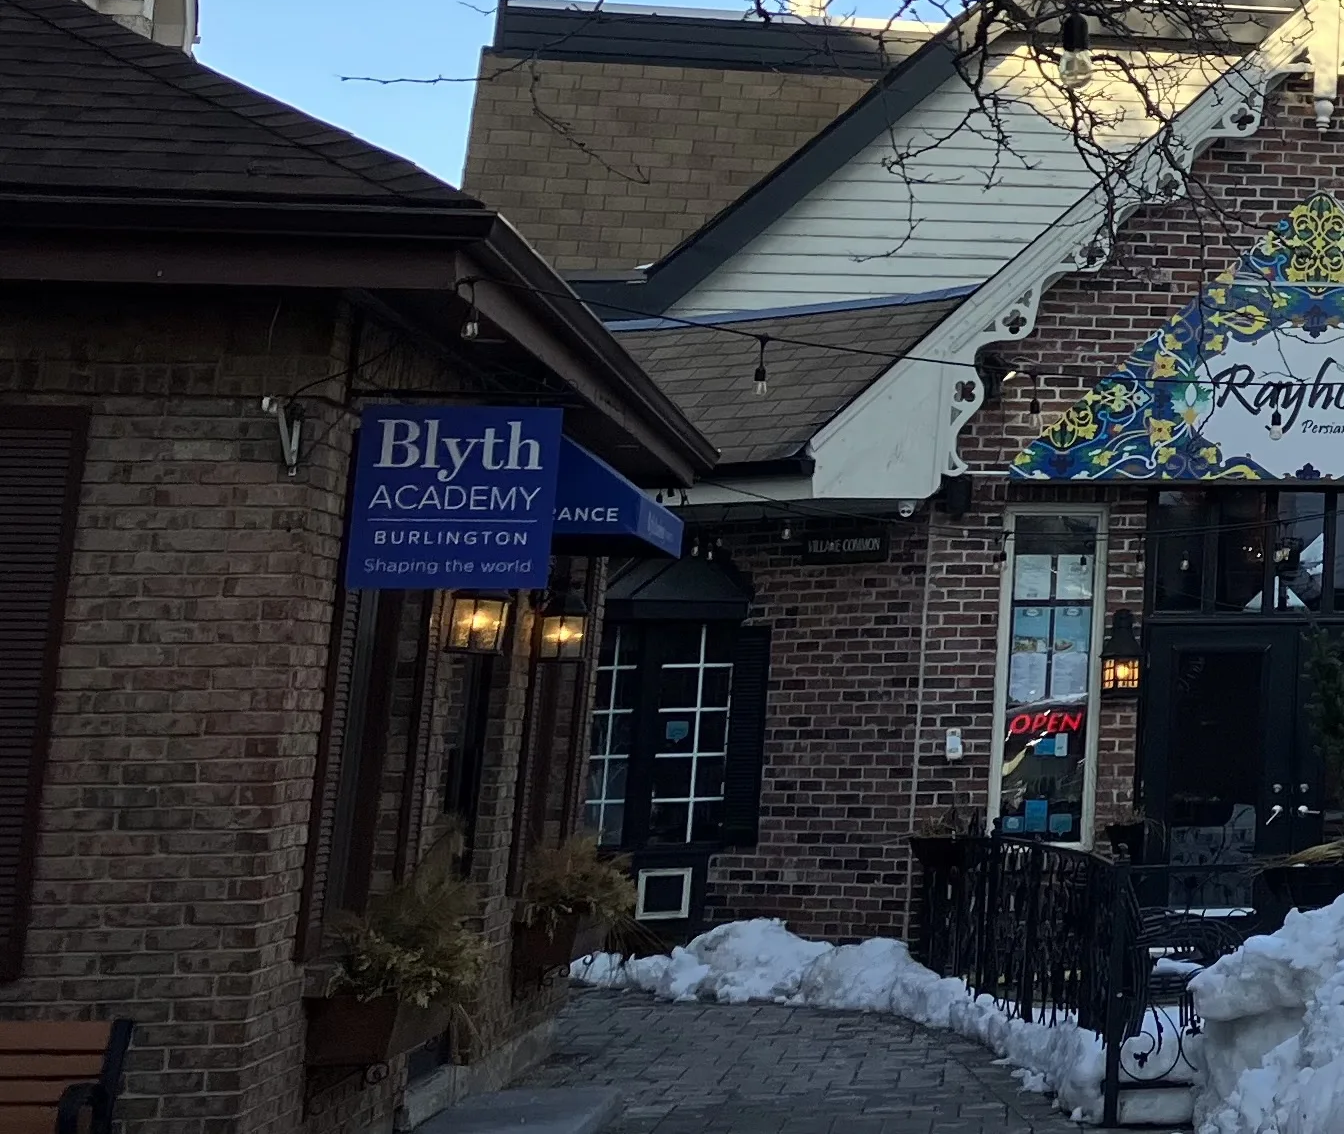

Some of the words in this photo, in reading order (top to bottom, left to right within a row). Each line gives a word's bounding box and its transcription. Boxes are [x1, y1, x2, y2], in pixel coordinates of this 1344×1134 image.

[372, 418, 543, 481] Blyth
[368, 484, 542, 512] ACADEMY
[374, 530, 528, 546] BURLINGTON
[842, 537, 880, 551] COMMON
[363, 558, 438, 574] Shaping
[445, 558, 474, 573] the
[480, 559, 532, 574] world
[1010, 712, 1082, 734] OPEN
